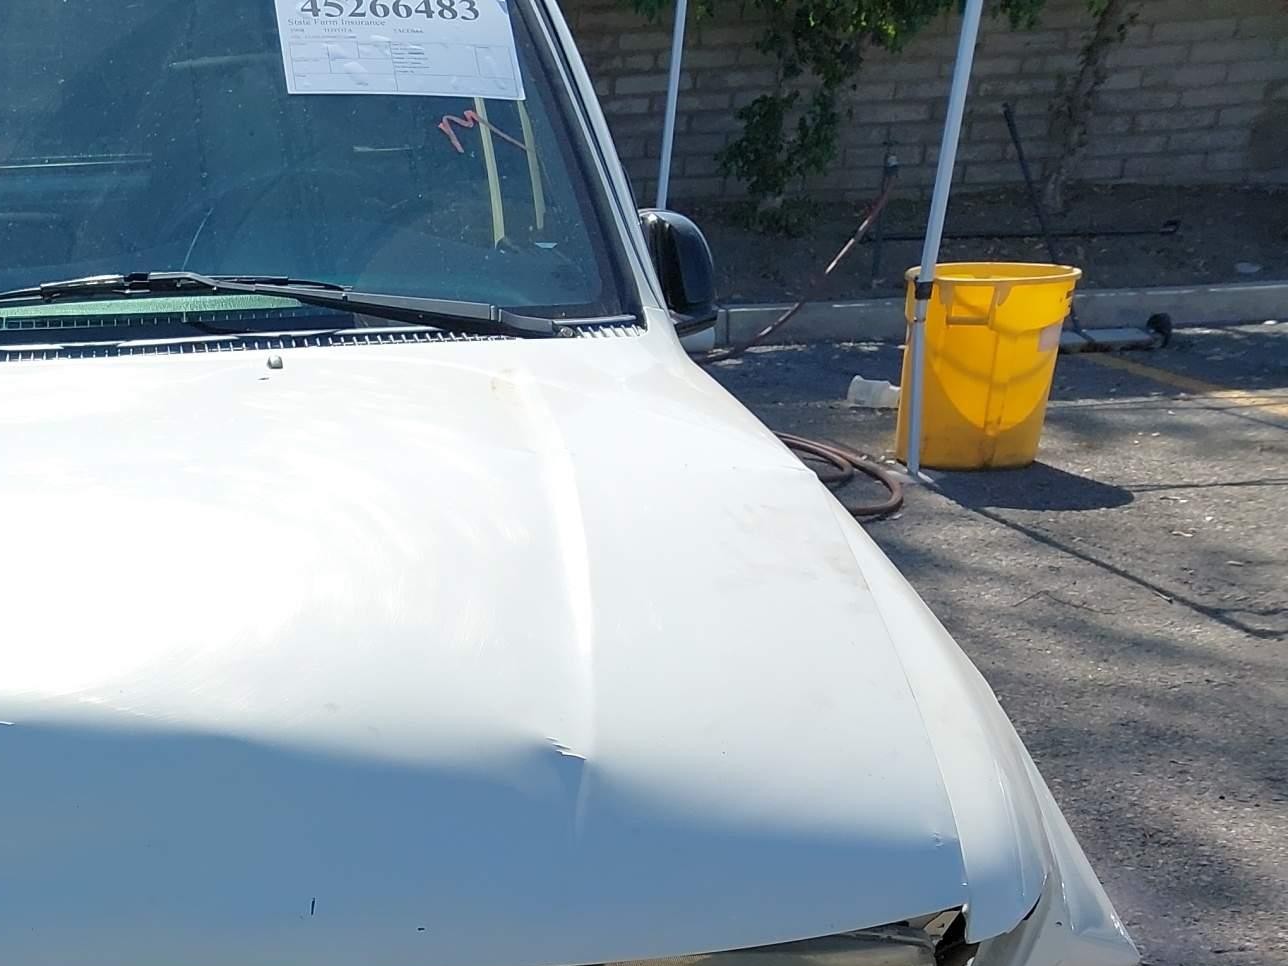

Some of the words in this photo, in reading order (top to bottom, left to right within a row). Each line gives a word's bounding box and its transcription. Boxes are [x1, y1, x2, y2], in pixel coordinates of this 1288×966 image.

[300, 0, 480, 20] 45266483
[287, 18, 311, 26] State
[314, 18, 338, 26] Farm
[341, 18, 387, 27] Insurance
